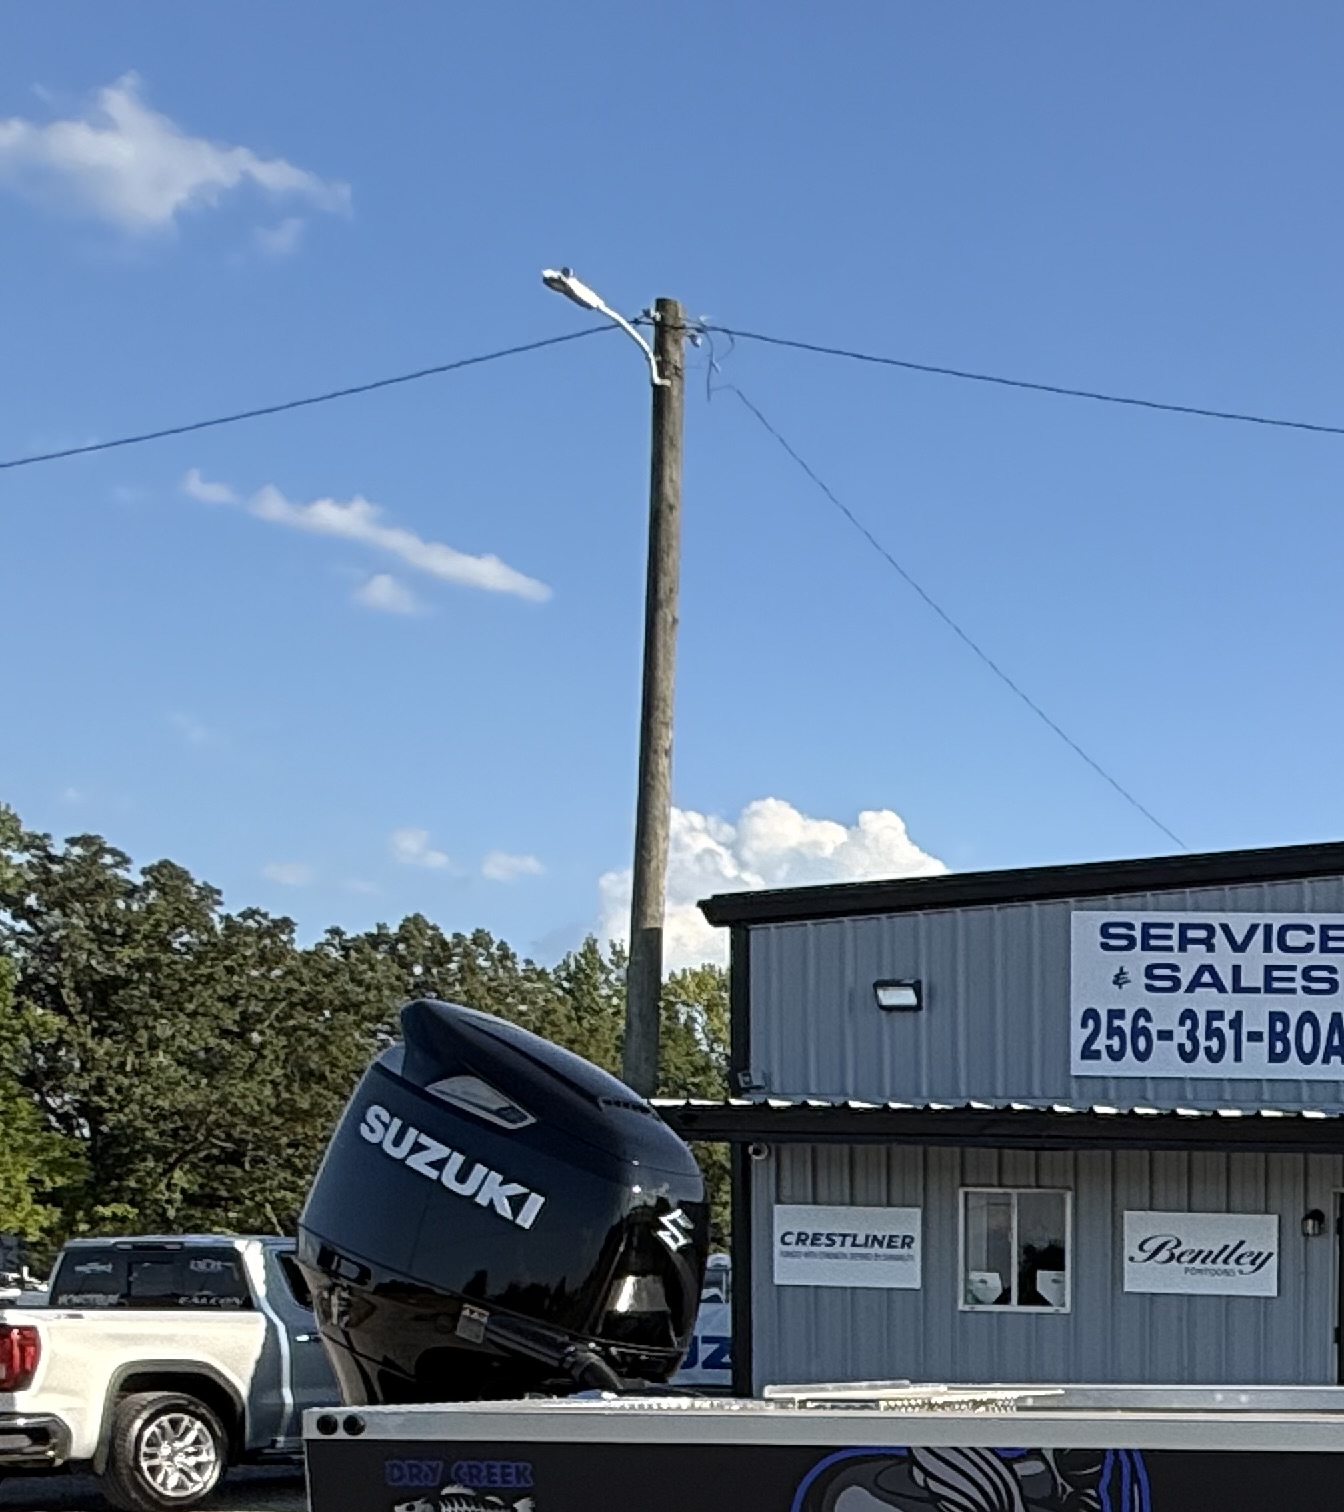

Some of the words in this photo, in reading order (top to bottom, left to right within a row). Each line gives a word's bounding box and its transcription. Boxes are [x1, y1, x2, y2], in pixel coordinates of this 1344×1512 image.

[1112, 966, 1131, 990] &
[1144, 962, 1340, 995] SALES
[358, 1104, 547, 1231] SUZUKI
[780, 1231, 916, 1250] CRESTLINER
[1128, 1233, 1275, 1276] Bentley
[384, 1459, 445, 1487] DRY
[451, 1460, 535, 1488] CREEK
